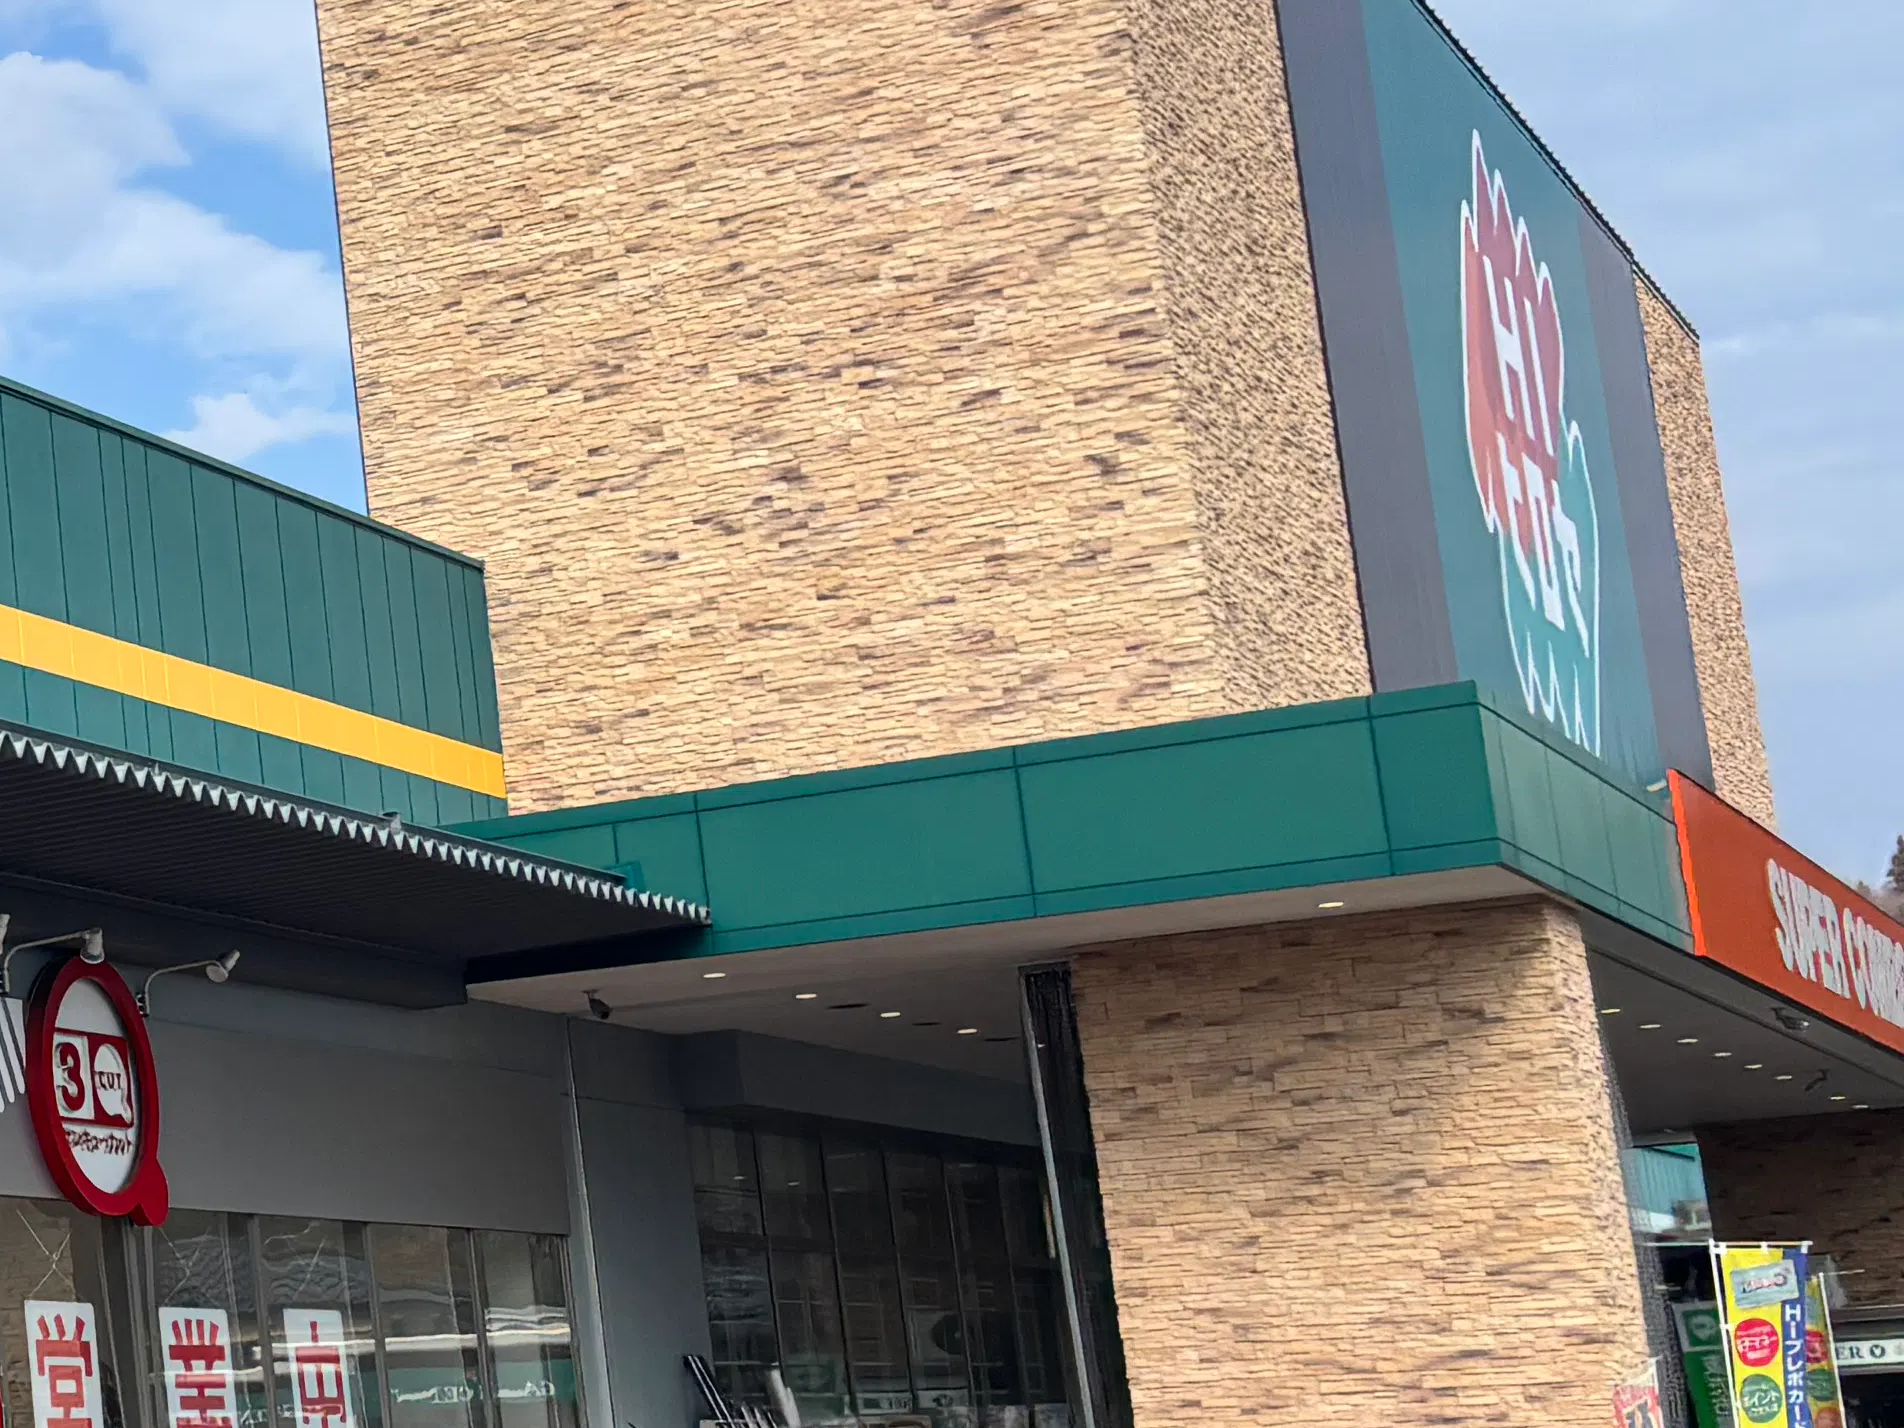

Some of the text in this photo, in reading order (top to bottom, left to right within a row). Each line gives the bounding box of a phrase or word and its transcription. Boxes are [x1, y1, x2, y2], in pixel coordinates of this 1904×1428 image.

[1483, 255, 1556, 456] HI
[1768, 858, 1852, 1000] SUPER
[97, 1071, 122, 1091] CUT
